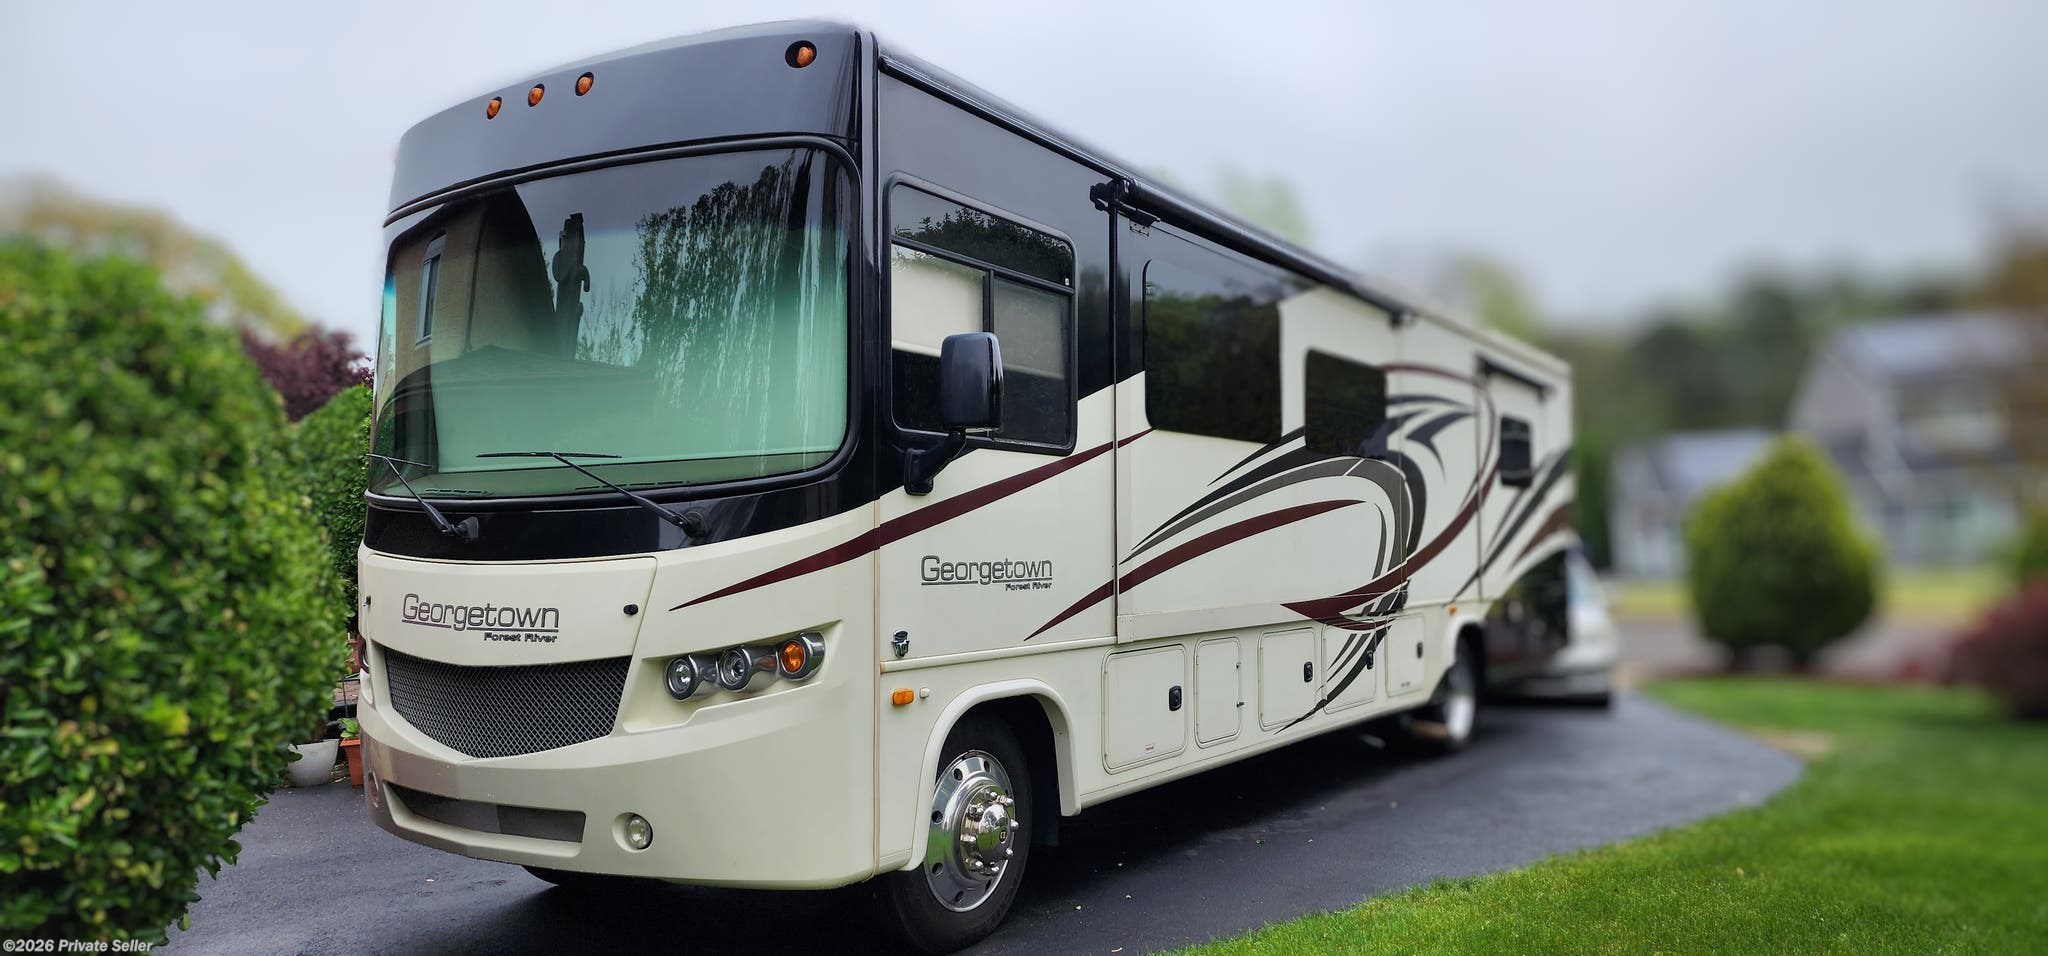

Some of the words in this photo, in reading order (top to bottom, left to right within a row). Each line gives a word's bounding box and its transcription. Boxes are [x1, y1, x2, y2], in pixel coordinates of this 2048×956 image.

[921, 554, 1053, 586] Georgetown
[1005, 582, 1031, 591] Forest
[1032, 581, 1052, 590] River
[401, 593, 560, 632] Georgetown
[483, 632, 521, 642] Forest
[524, 633, 558, 643] River
